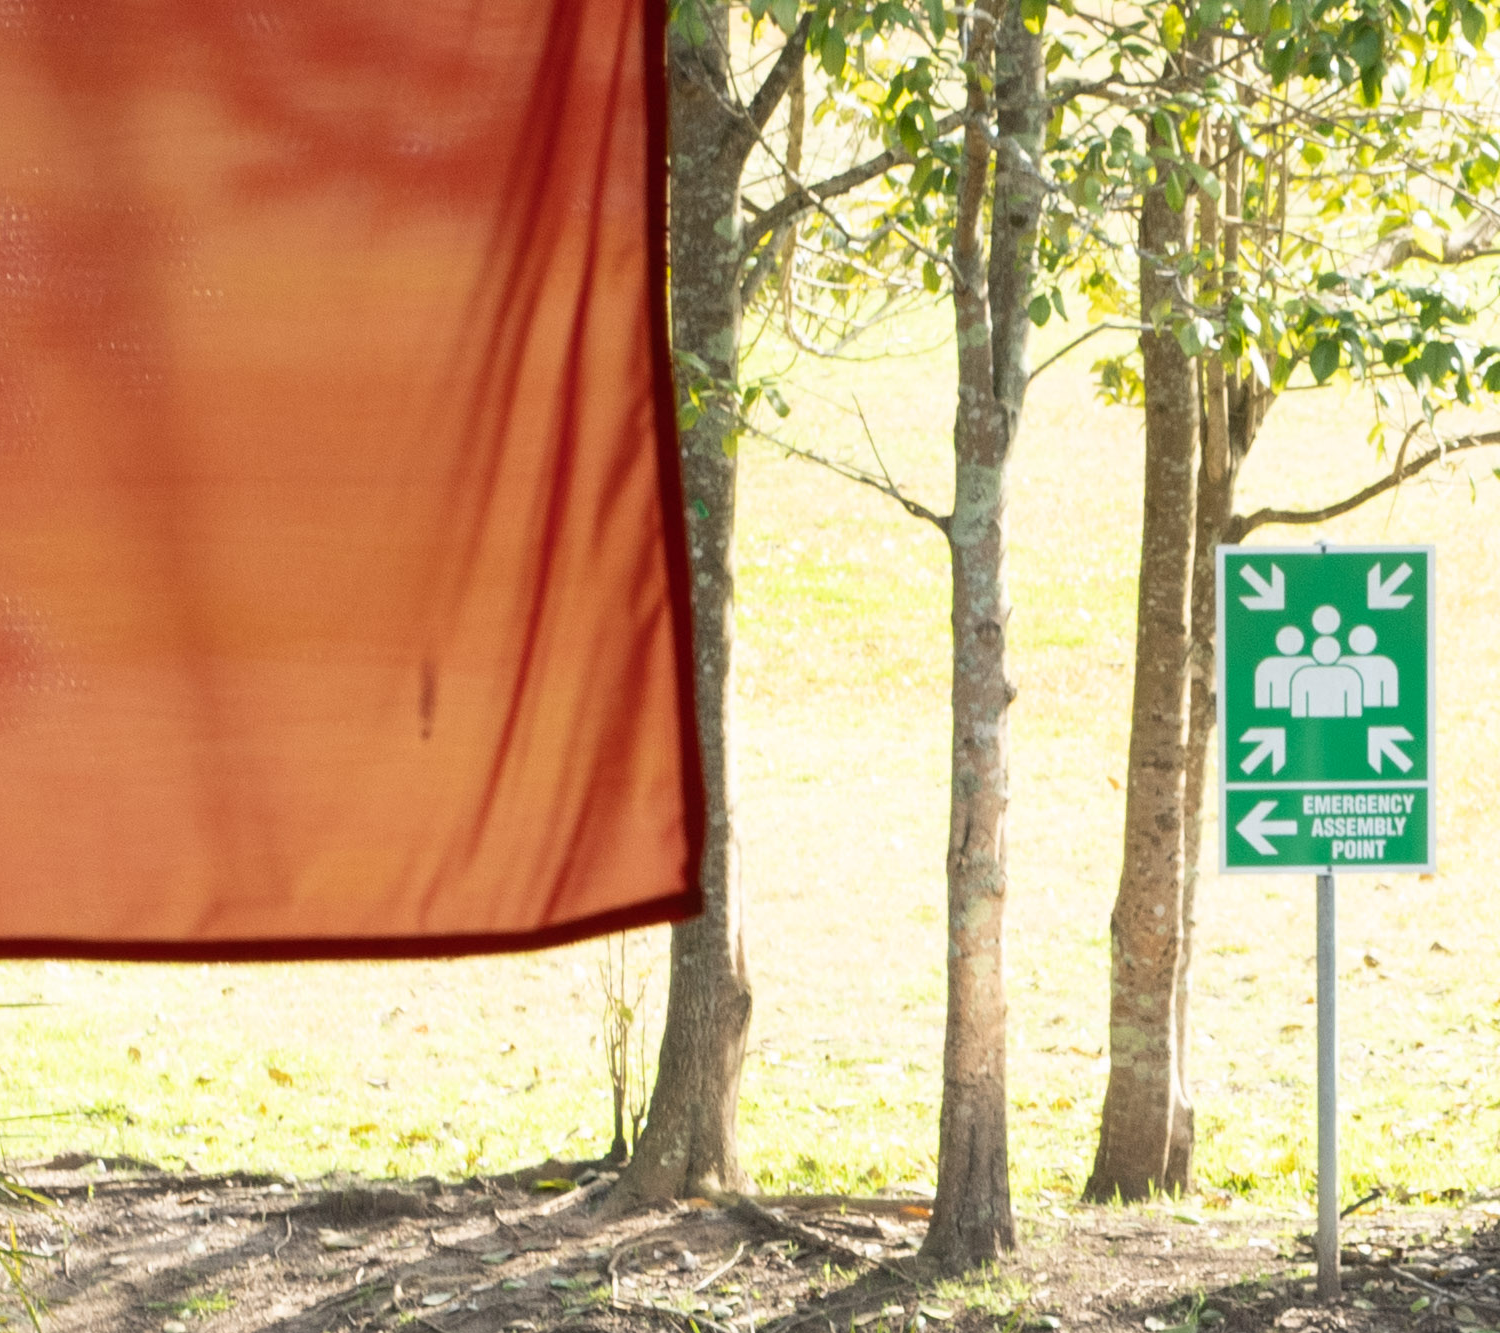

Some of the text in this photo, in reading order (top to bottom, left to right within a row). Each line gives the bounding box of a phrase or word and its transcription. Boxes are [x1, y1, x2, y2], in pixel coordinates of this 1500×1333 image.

[1303, 794, 1414, 815] EMERGENCY
[1311, 817, 1407, 837] ASSEMBLY
[1331, 839, 1387, 859] POINT
